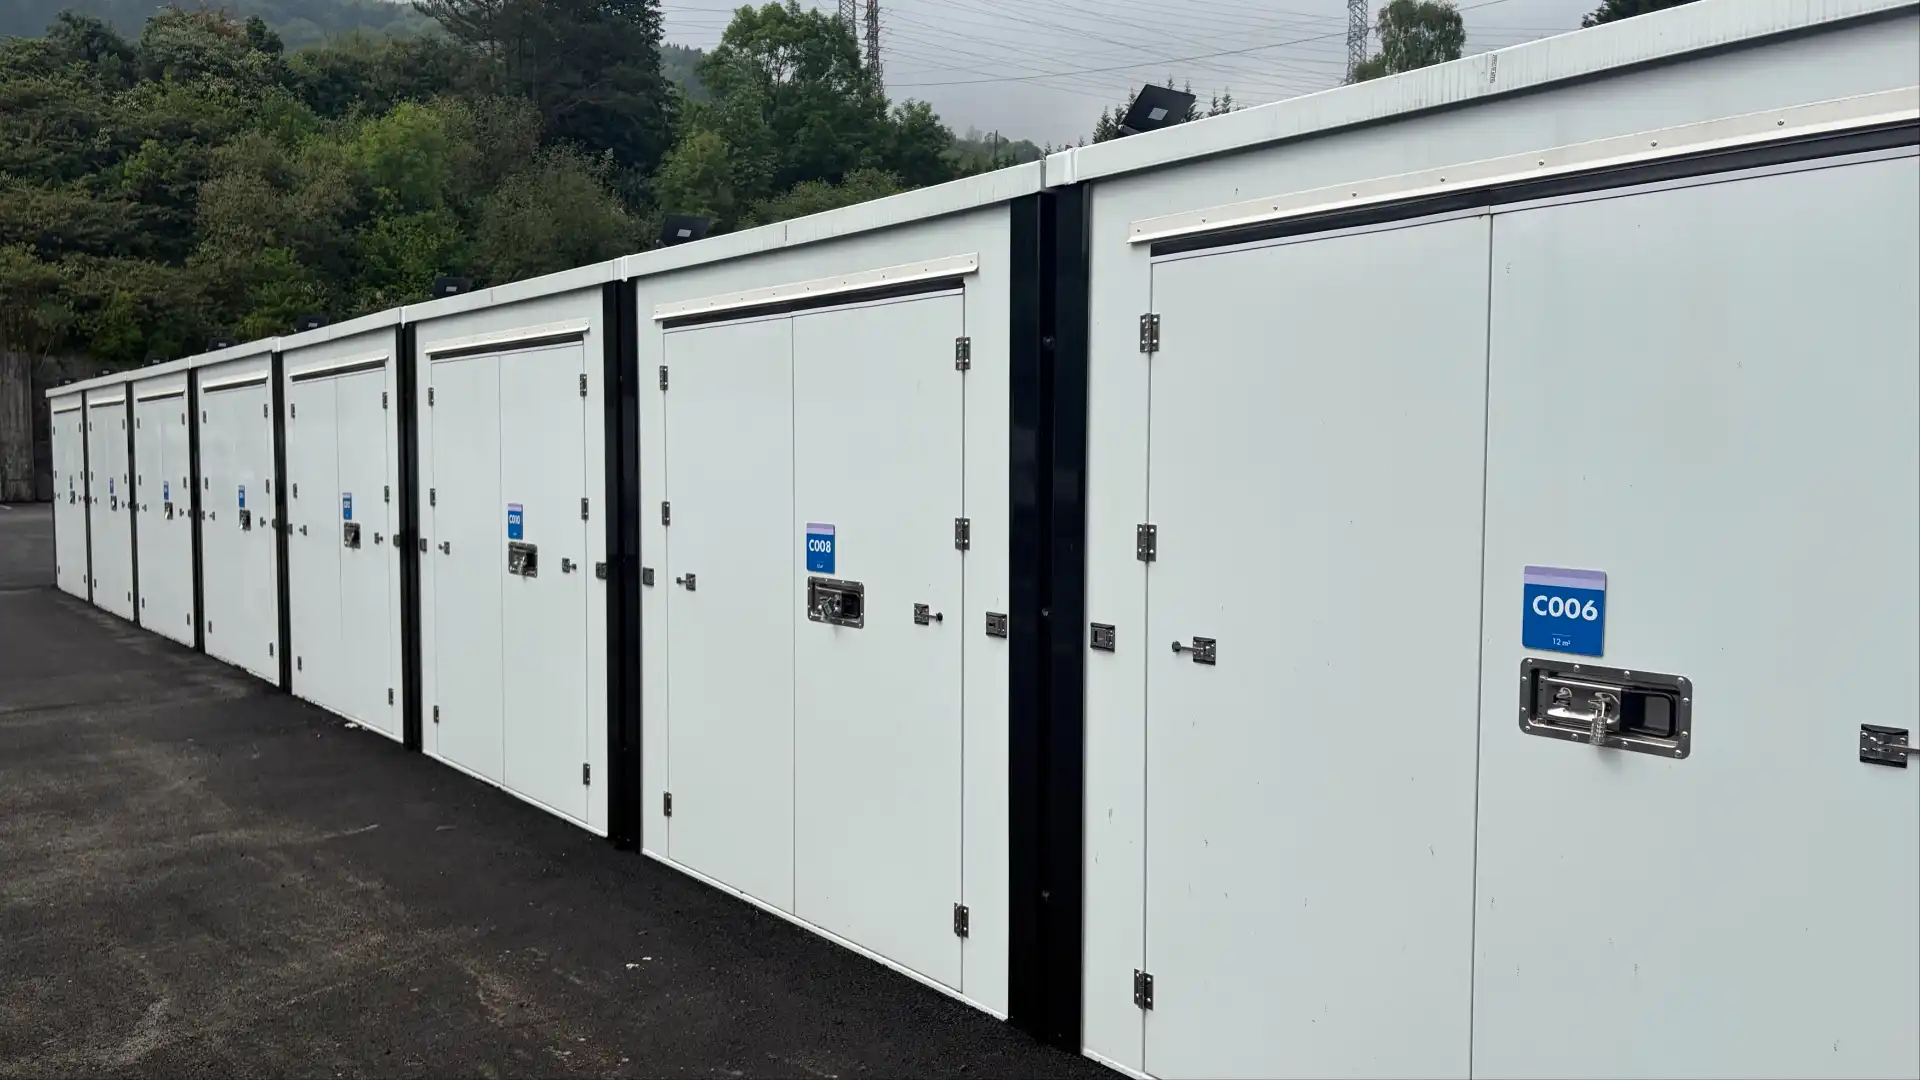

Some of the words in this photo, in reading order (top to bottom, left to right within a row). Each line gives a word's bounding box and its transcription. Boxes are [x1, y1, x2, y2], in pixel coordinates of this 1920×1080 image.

[808, 539, 831, 553] C008
[1532, 594, 1599, 621] C006
[1552, 637, 1561, 646] 12
